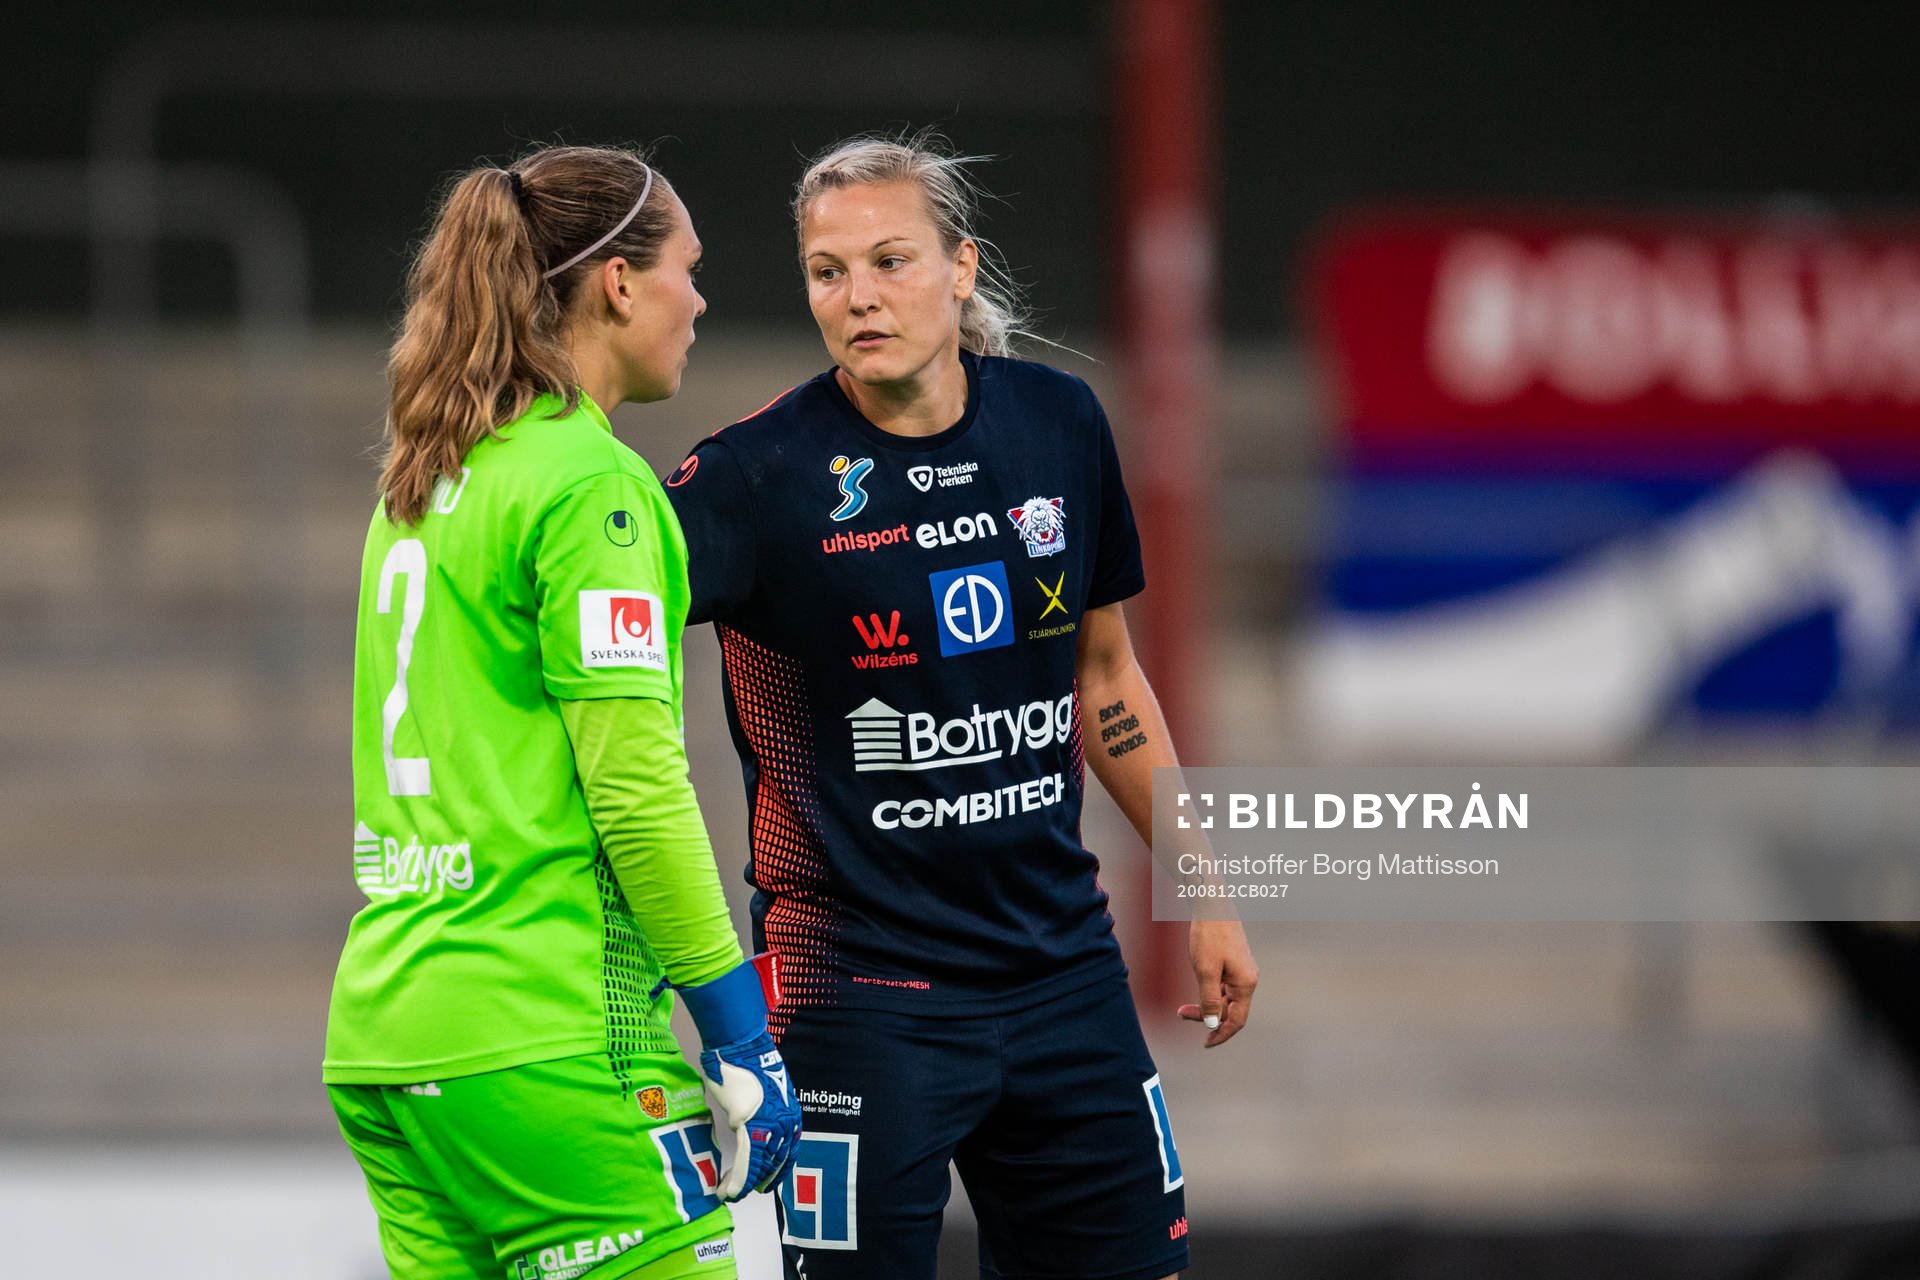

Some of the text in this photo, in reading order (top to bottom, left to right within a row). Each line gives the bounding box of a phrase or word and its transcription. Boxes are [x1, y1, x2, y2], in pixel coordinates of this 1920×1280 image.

[934, 462, 978, 478] Tekniska
[822, 523, 911, 553] uhlsport
[376, 538, 431, 796] 2
[591, 649, 665, 665] SVENSKA SPEL
[851, 651, 918, 669] Wilzéns
[907, 693, 1073, 761] Botrygg
[538, 1230, 643, 1272] QLEAN
